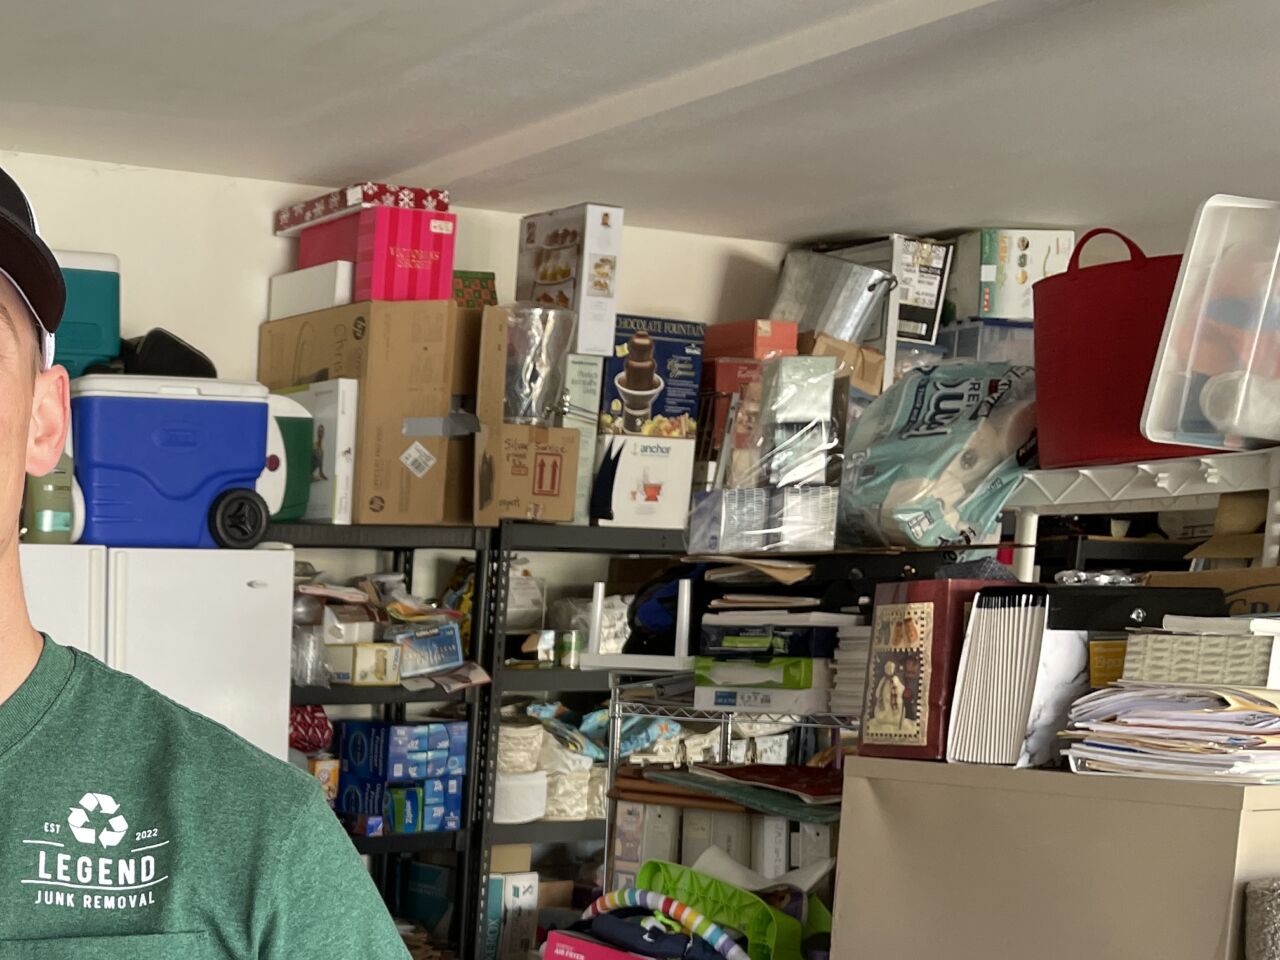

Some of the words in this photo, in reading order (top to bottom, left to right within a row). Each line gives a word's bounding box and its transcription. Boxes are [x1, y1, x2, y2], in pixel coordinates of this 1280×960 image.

[663, 322, 705, 336] FOUNTAIN
[640, 442, 672, 454] anchor
[44, 822, 60, 834] EST
[135, 828, 158, 841] 2022
[38, 851, 155, 885] LEGEND
[35, 890, 75, 908] JUNK
[83, 891, 155, 909] REMOVAL
[554, 947, 565, 957] AIR
[565, 950, 585, 960] FRYER
